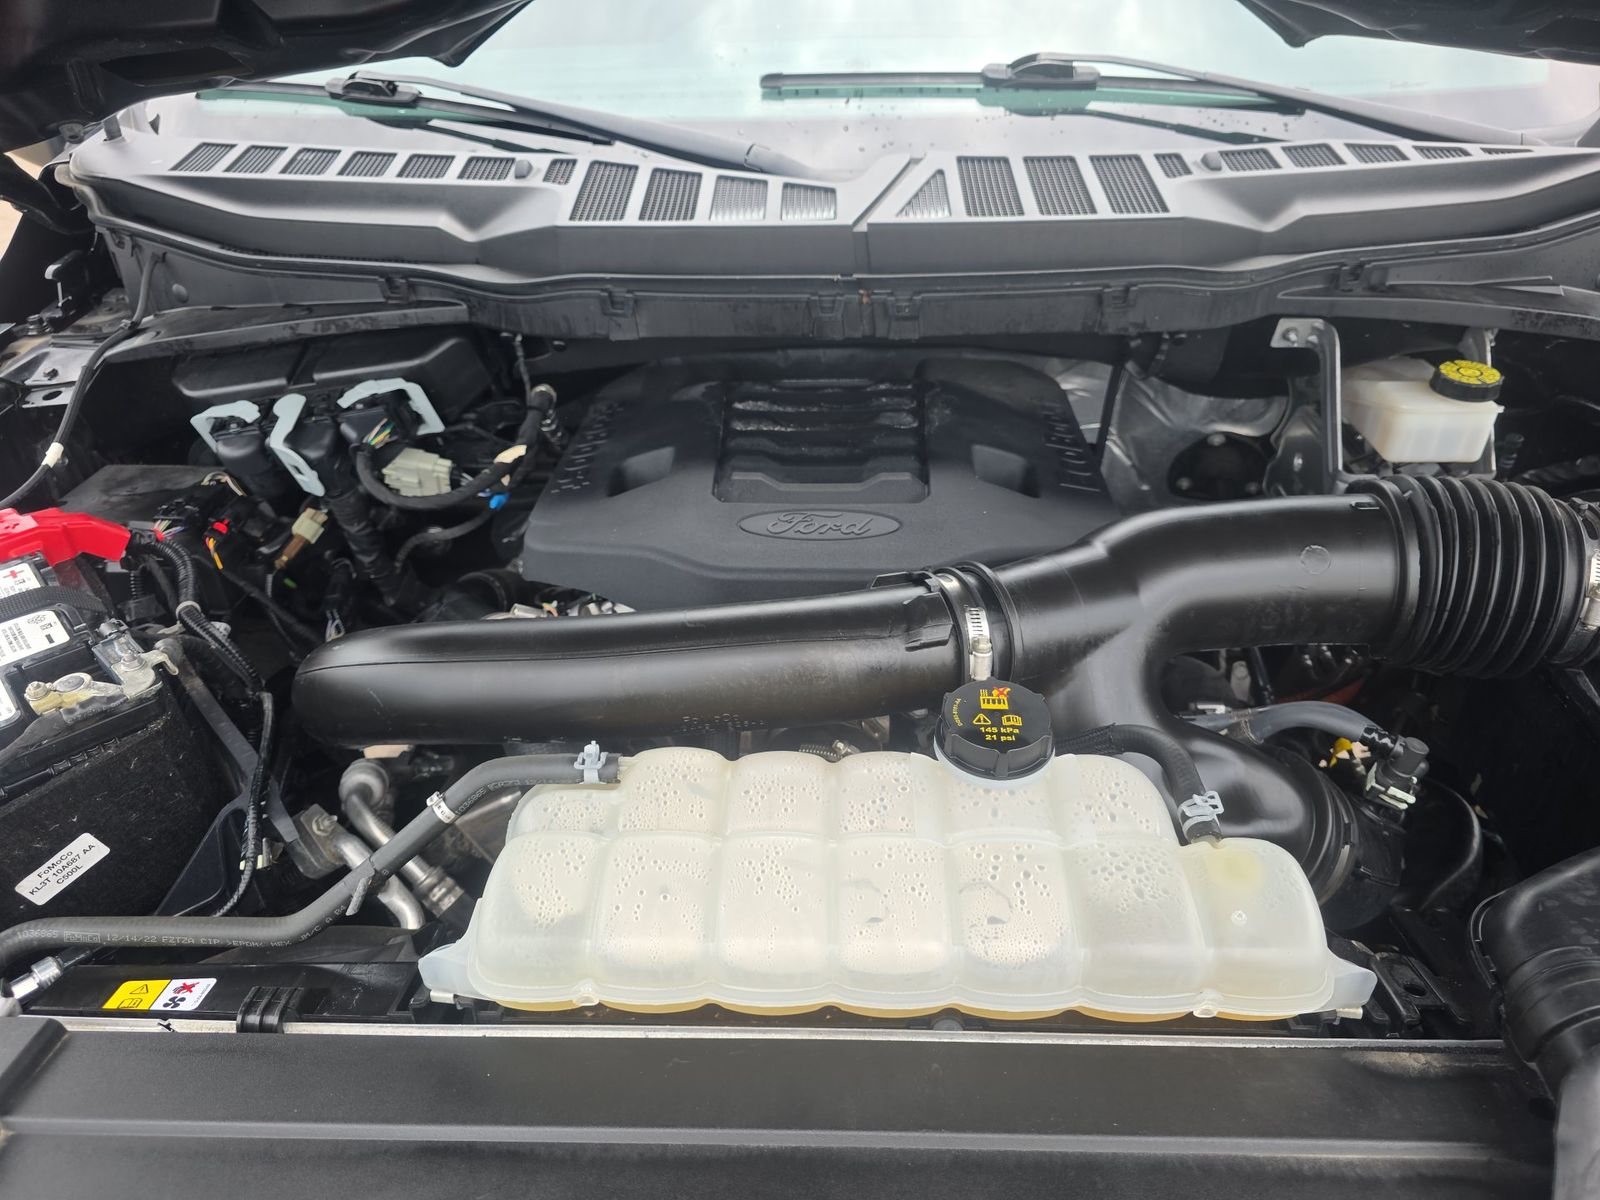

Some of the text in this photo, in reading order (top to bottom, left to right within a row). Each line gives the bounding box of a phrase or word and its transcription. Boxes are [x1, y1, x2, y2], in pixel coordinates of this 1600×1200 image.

[766, 512, 873, 536] Ford
[980, 726, 1020, 734] 145 kPa
[1000, 734, 1016, 742] psi
[29, 843, 96, 896] KL3T 10A687 AA
[37, 850, 73, 879] FoMoCo
[56, 864, 84, 885] C500L
[106, 933, 157, 942] 12/14/22
